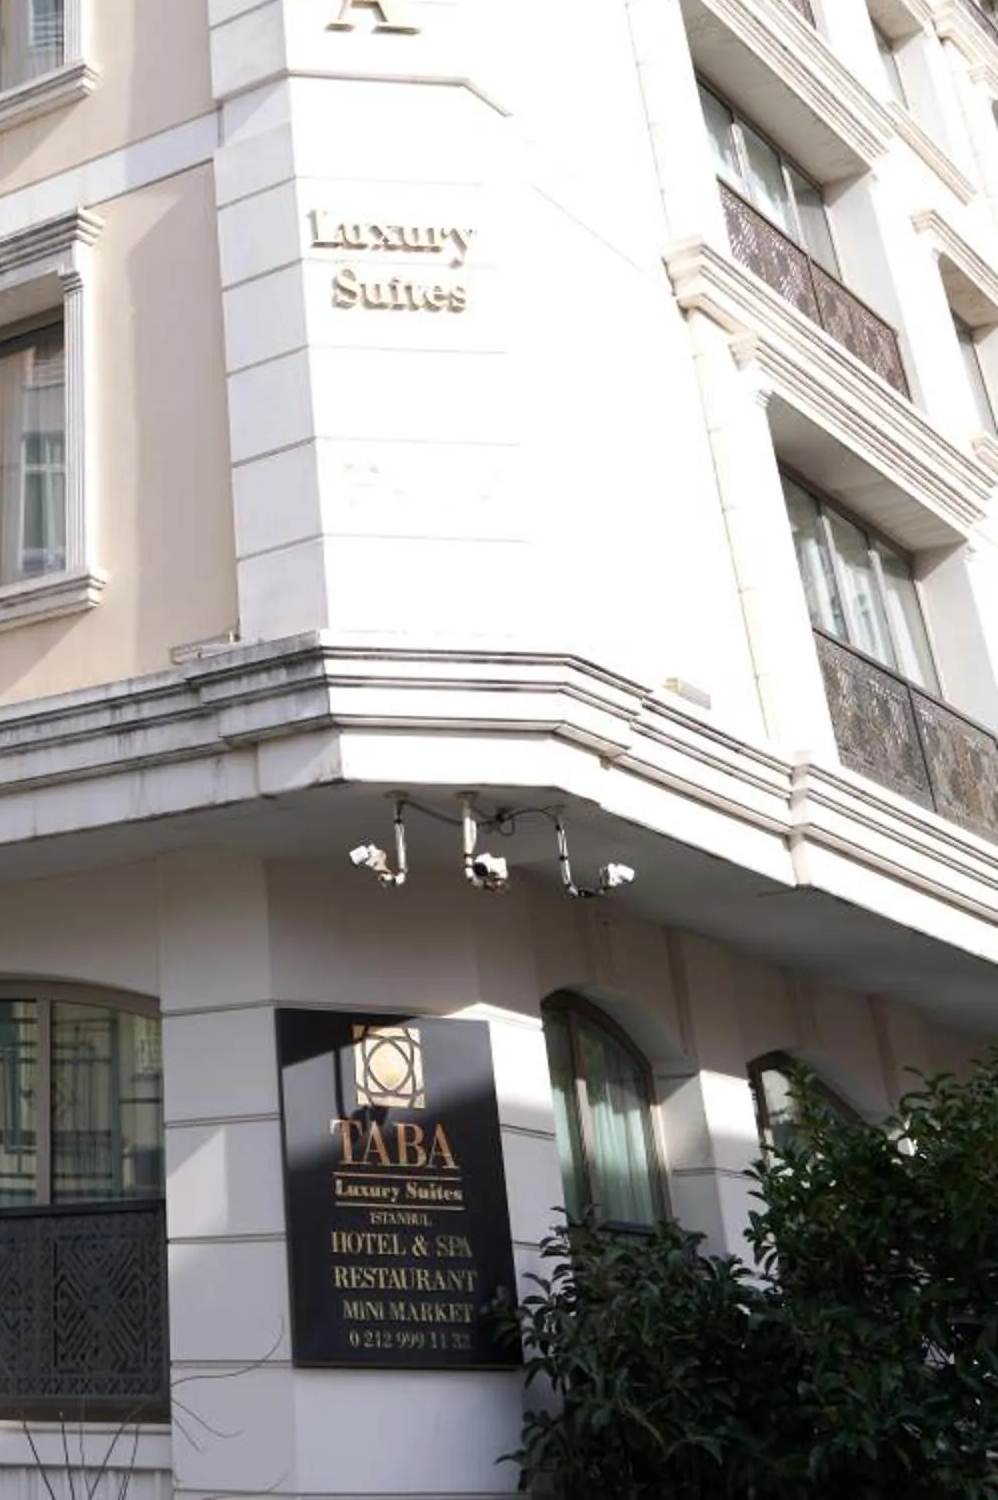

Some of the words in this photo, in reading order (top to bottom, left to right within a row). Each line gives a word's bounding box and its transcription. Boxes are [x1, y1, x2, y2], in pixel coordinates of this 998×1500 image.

[306, 209, 477, 269] Luxury
[332, 268, 467, 314] Suites
[329, 1118, 461, 1170] TABA
[335, 1178, 400, 1203] Luxury
[406, 1181, 464, 1201] Suites
[331, 1231, 407, 1256] HOTEL
[411, 1235, 428, 1257] &
[435, 1235, 473, 1258] SPA
[332, 1265, 478, 1292] RESTAURANT
[389, 1301, 474, 1323] MARKET
[349, 1330, 360, 1348] 0
[363, 1330, 394, 1348] 212
